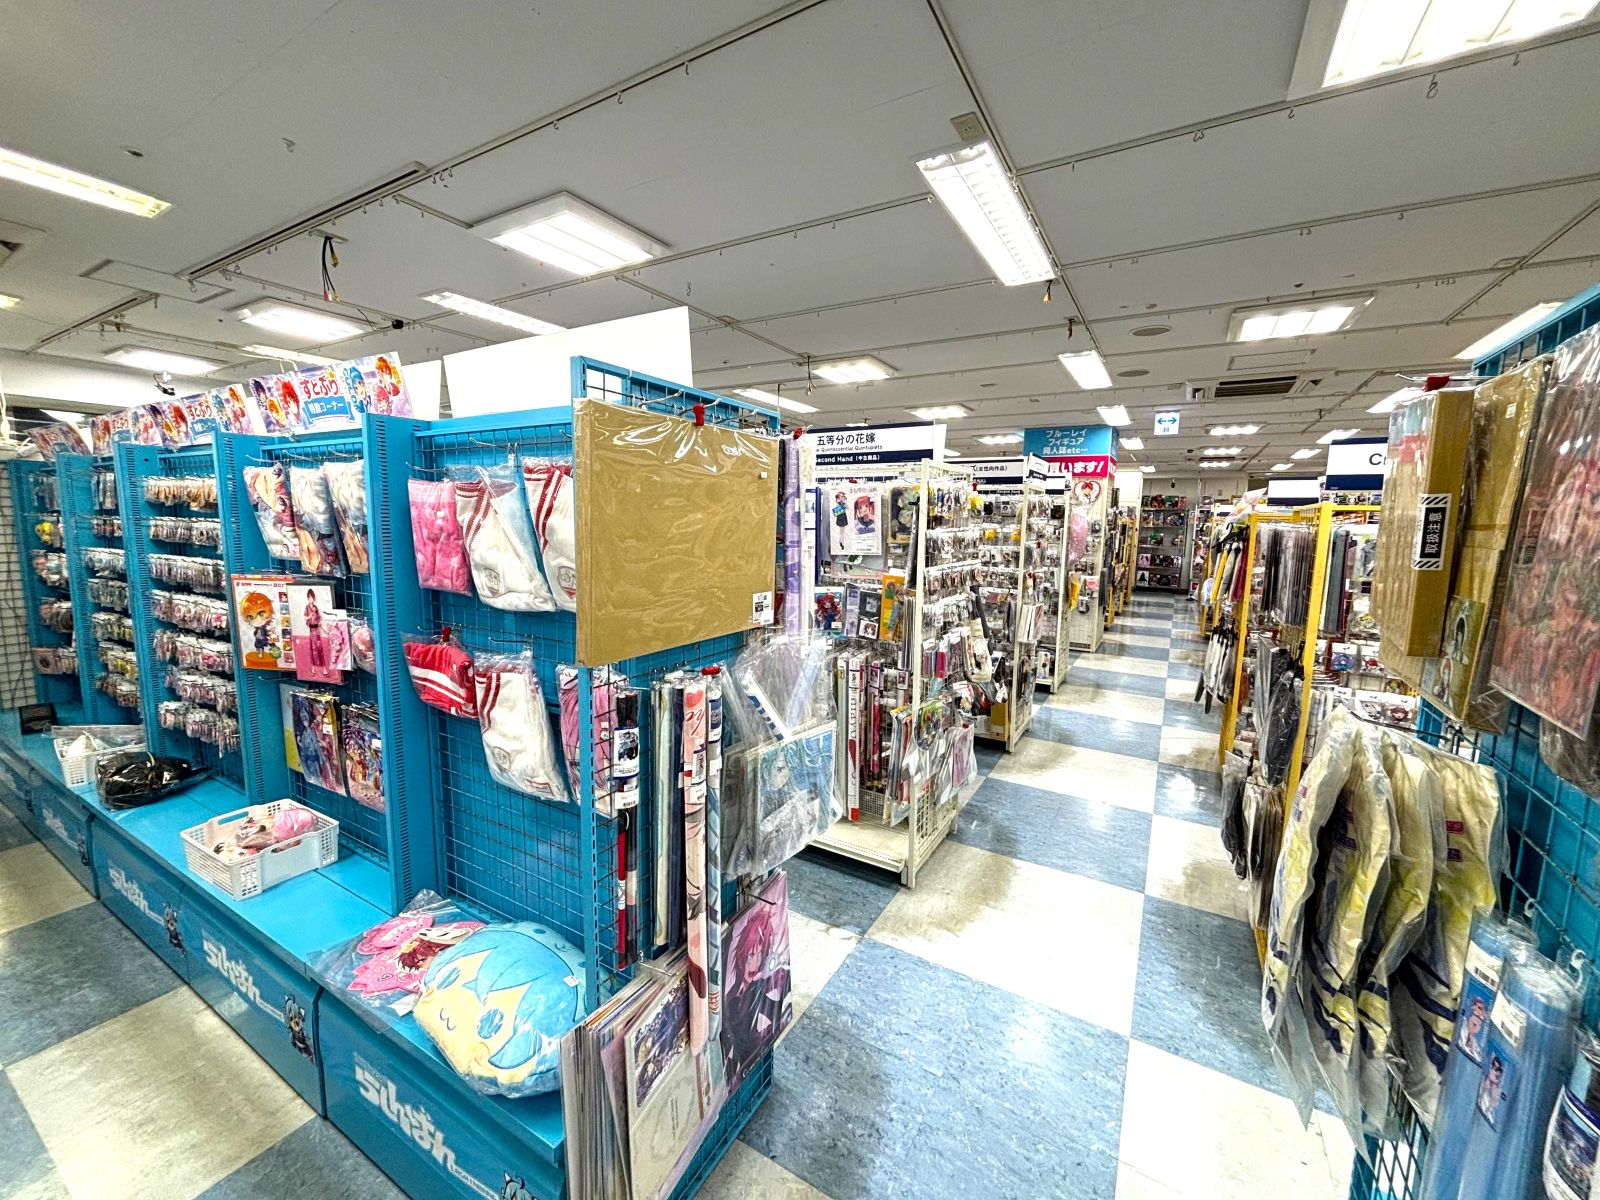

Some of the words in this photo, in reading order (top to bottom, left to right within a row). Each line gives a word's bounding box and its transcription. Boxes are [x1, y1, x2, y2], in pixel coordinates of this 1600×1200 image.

[816, 432, 876, 446] 五等分の花嫁
[1045, 428, 1088, 438] ブルーレイ
[1048, 437, 1085, 446] フィギュア
[1424, 511, 1442, 554] 取扱注意
[355, 1065, 457, 1171] らしんばん
